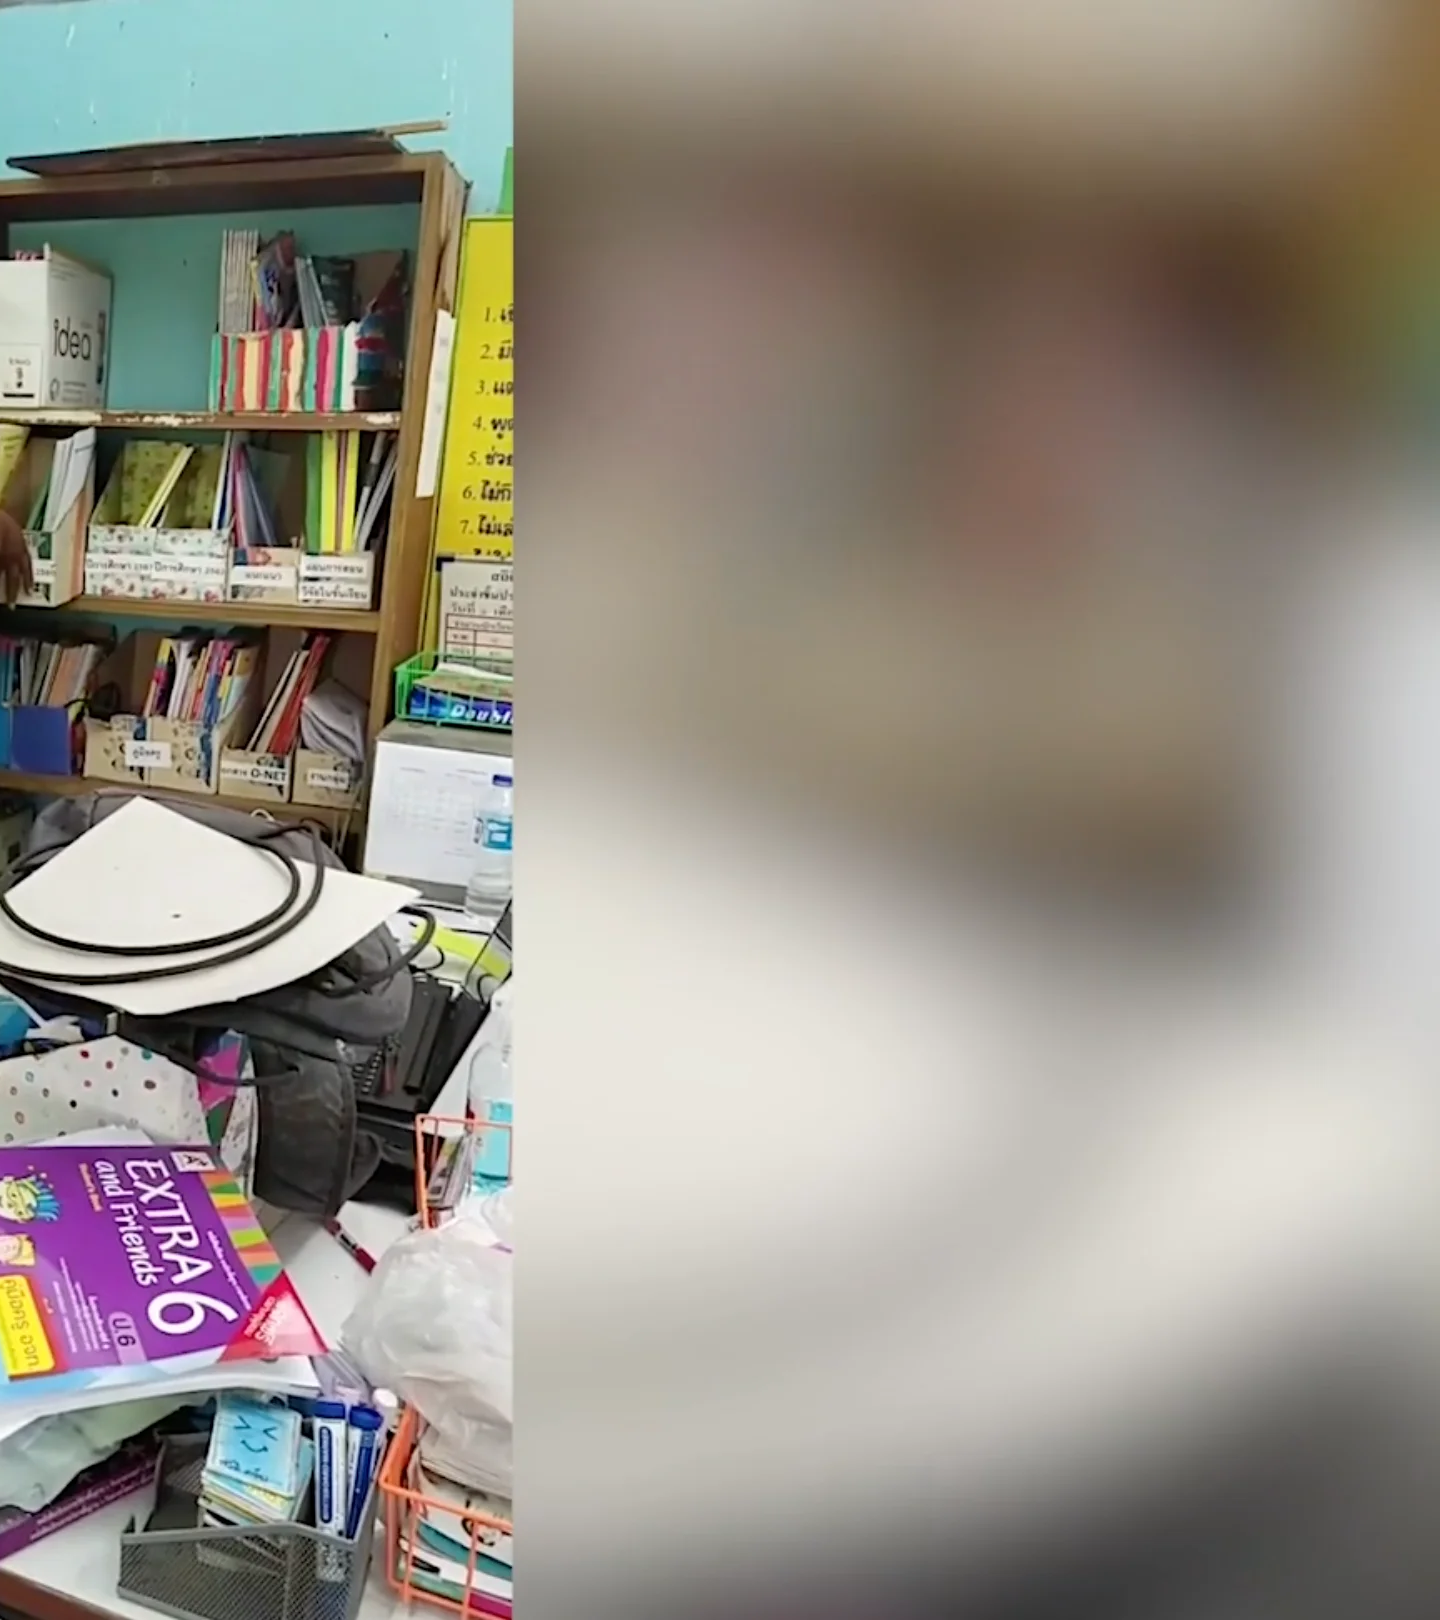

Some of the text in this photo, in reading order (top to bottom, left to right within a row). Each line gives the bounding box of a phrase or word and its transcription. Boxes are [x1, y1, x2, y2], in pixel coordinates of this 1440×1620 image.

[53, 316, 91, 360] idea
[250, 768, 287, 781] O-NET
[94, 1160, 165, 1286] and Friends
[125, 1159, 213, 1285] EXTRA
[147, 1290, 239, 1335] 6
